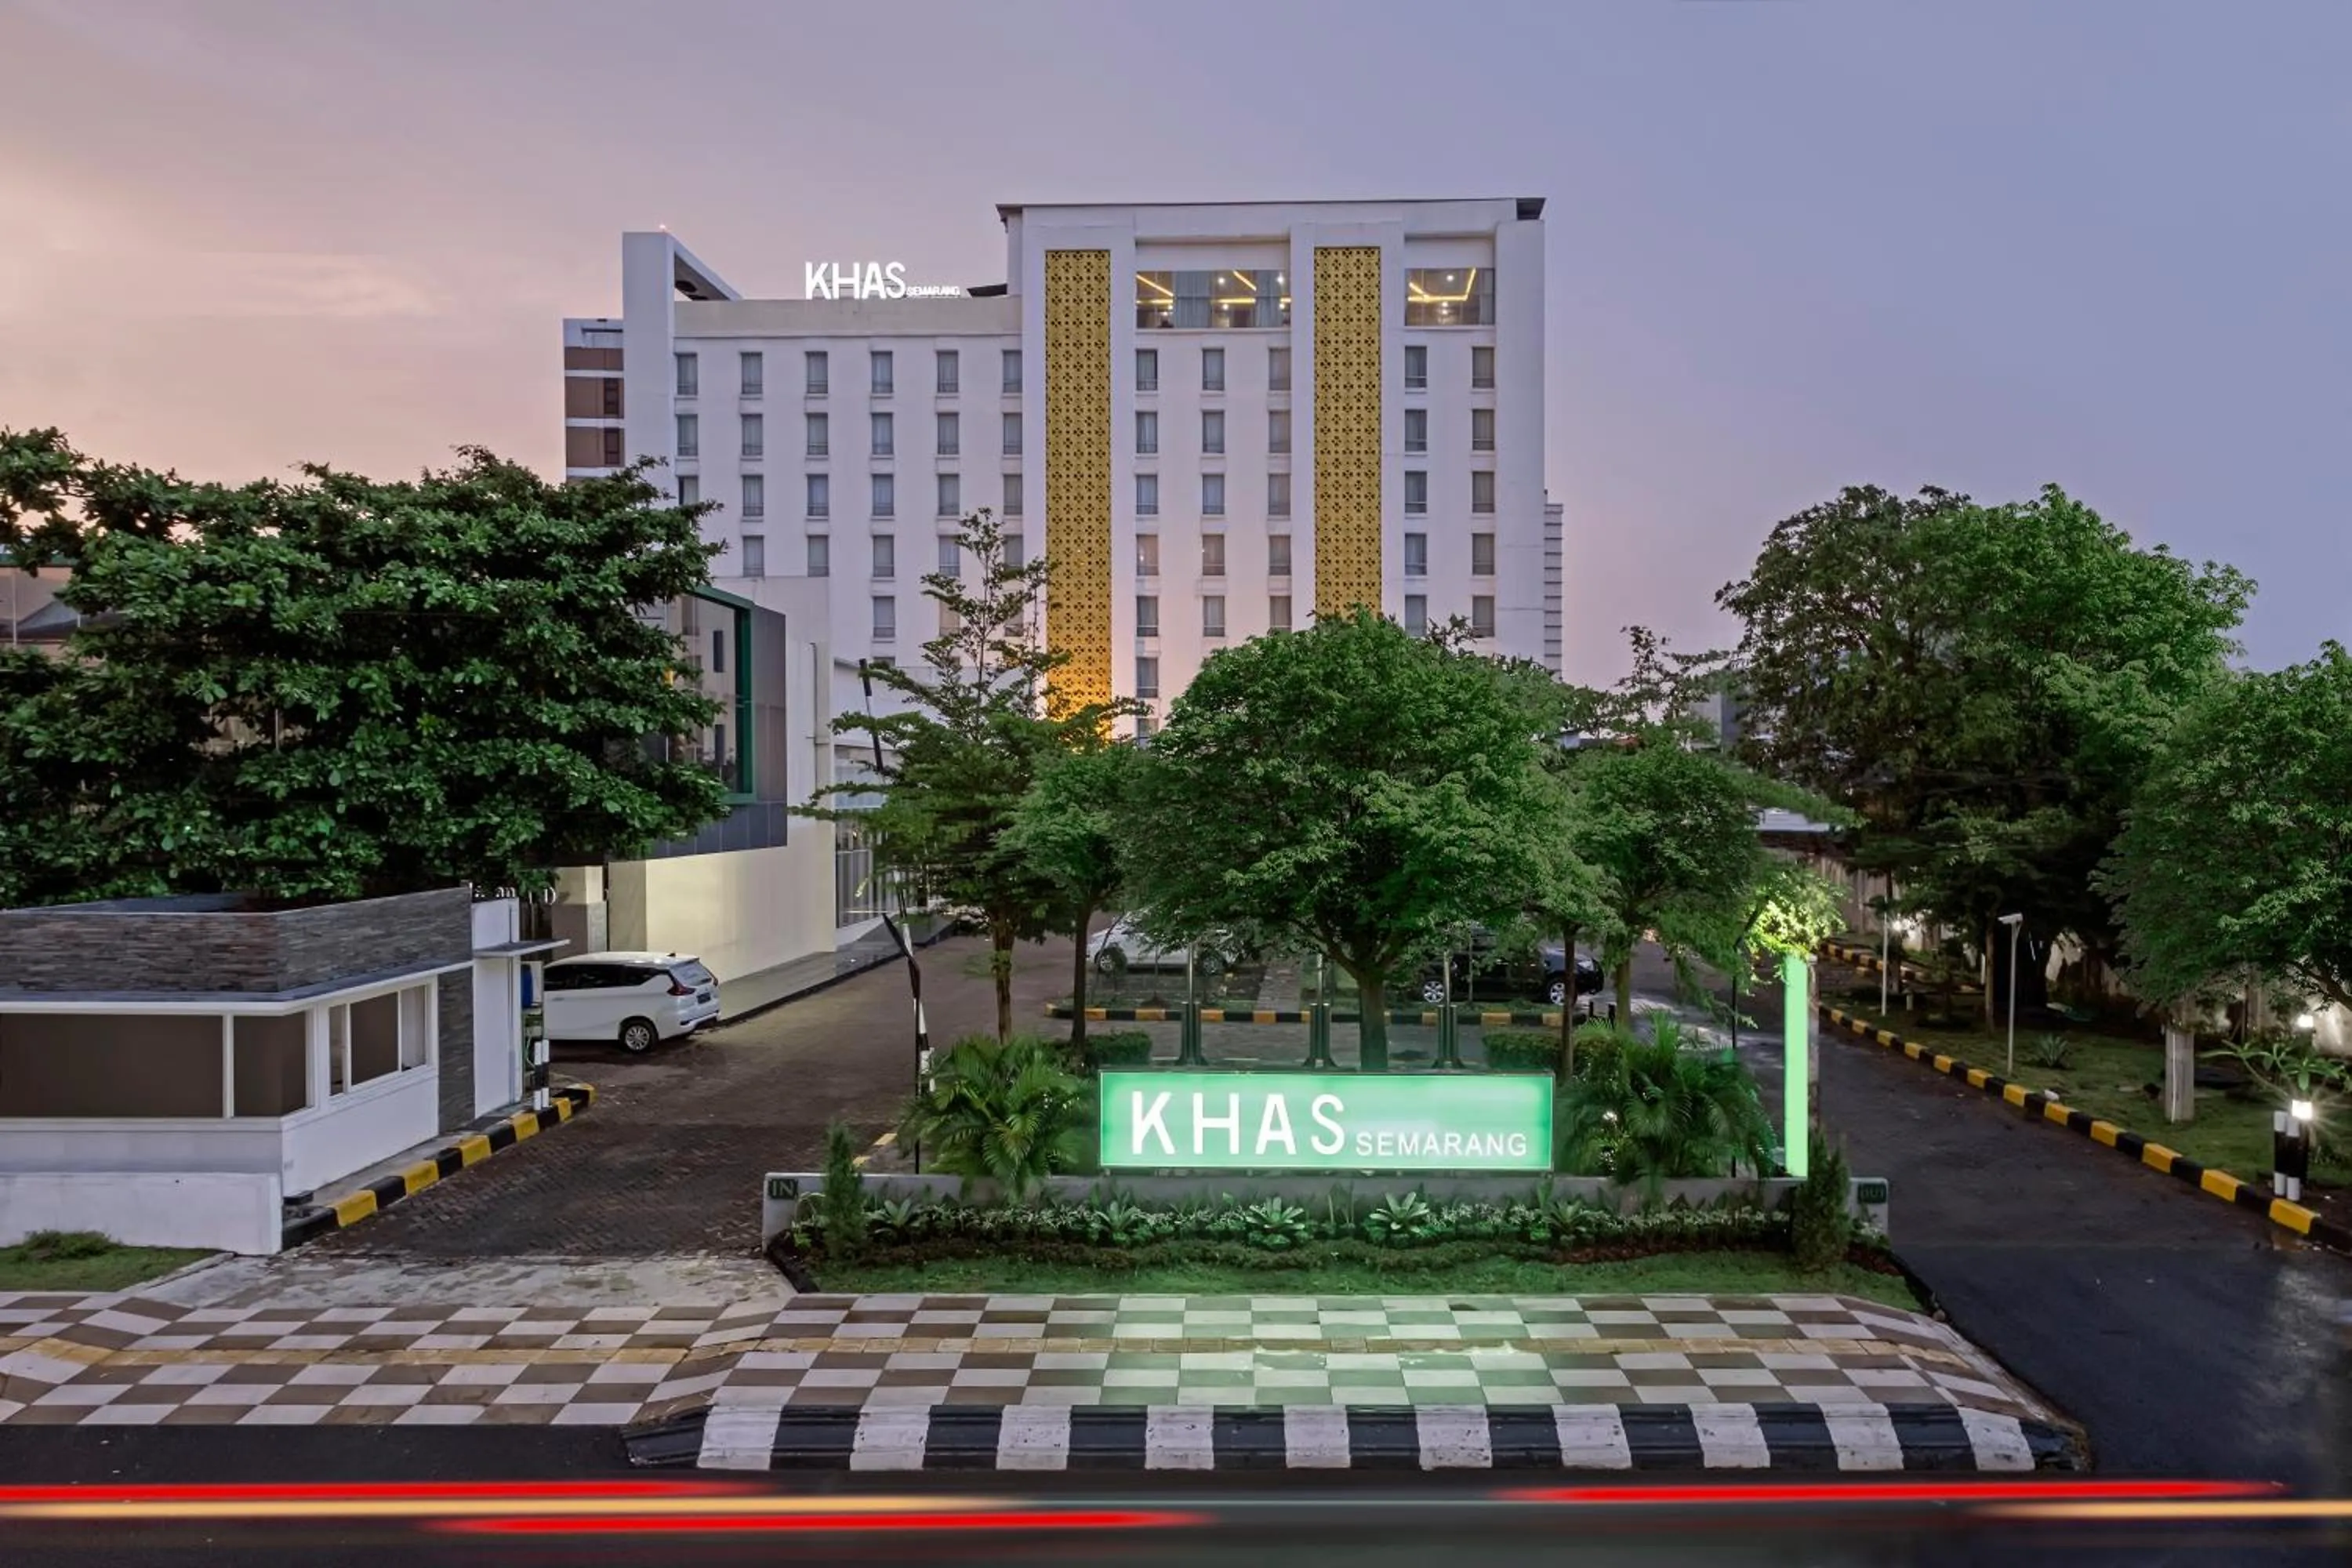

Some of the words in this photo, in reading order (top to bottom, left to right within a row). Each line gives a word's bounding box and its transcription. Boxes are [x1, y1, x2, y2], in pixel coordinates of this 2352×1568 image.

[805, 262, 906, 299] KHAS
[906, 285, 960, 296] SEMARANG
[1131, 1091, 1345, 1155] KHAS
[1356, 1131, 1527, 1156] SEMARANG
[772, 1180, 794, 1196] IN
